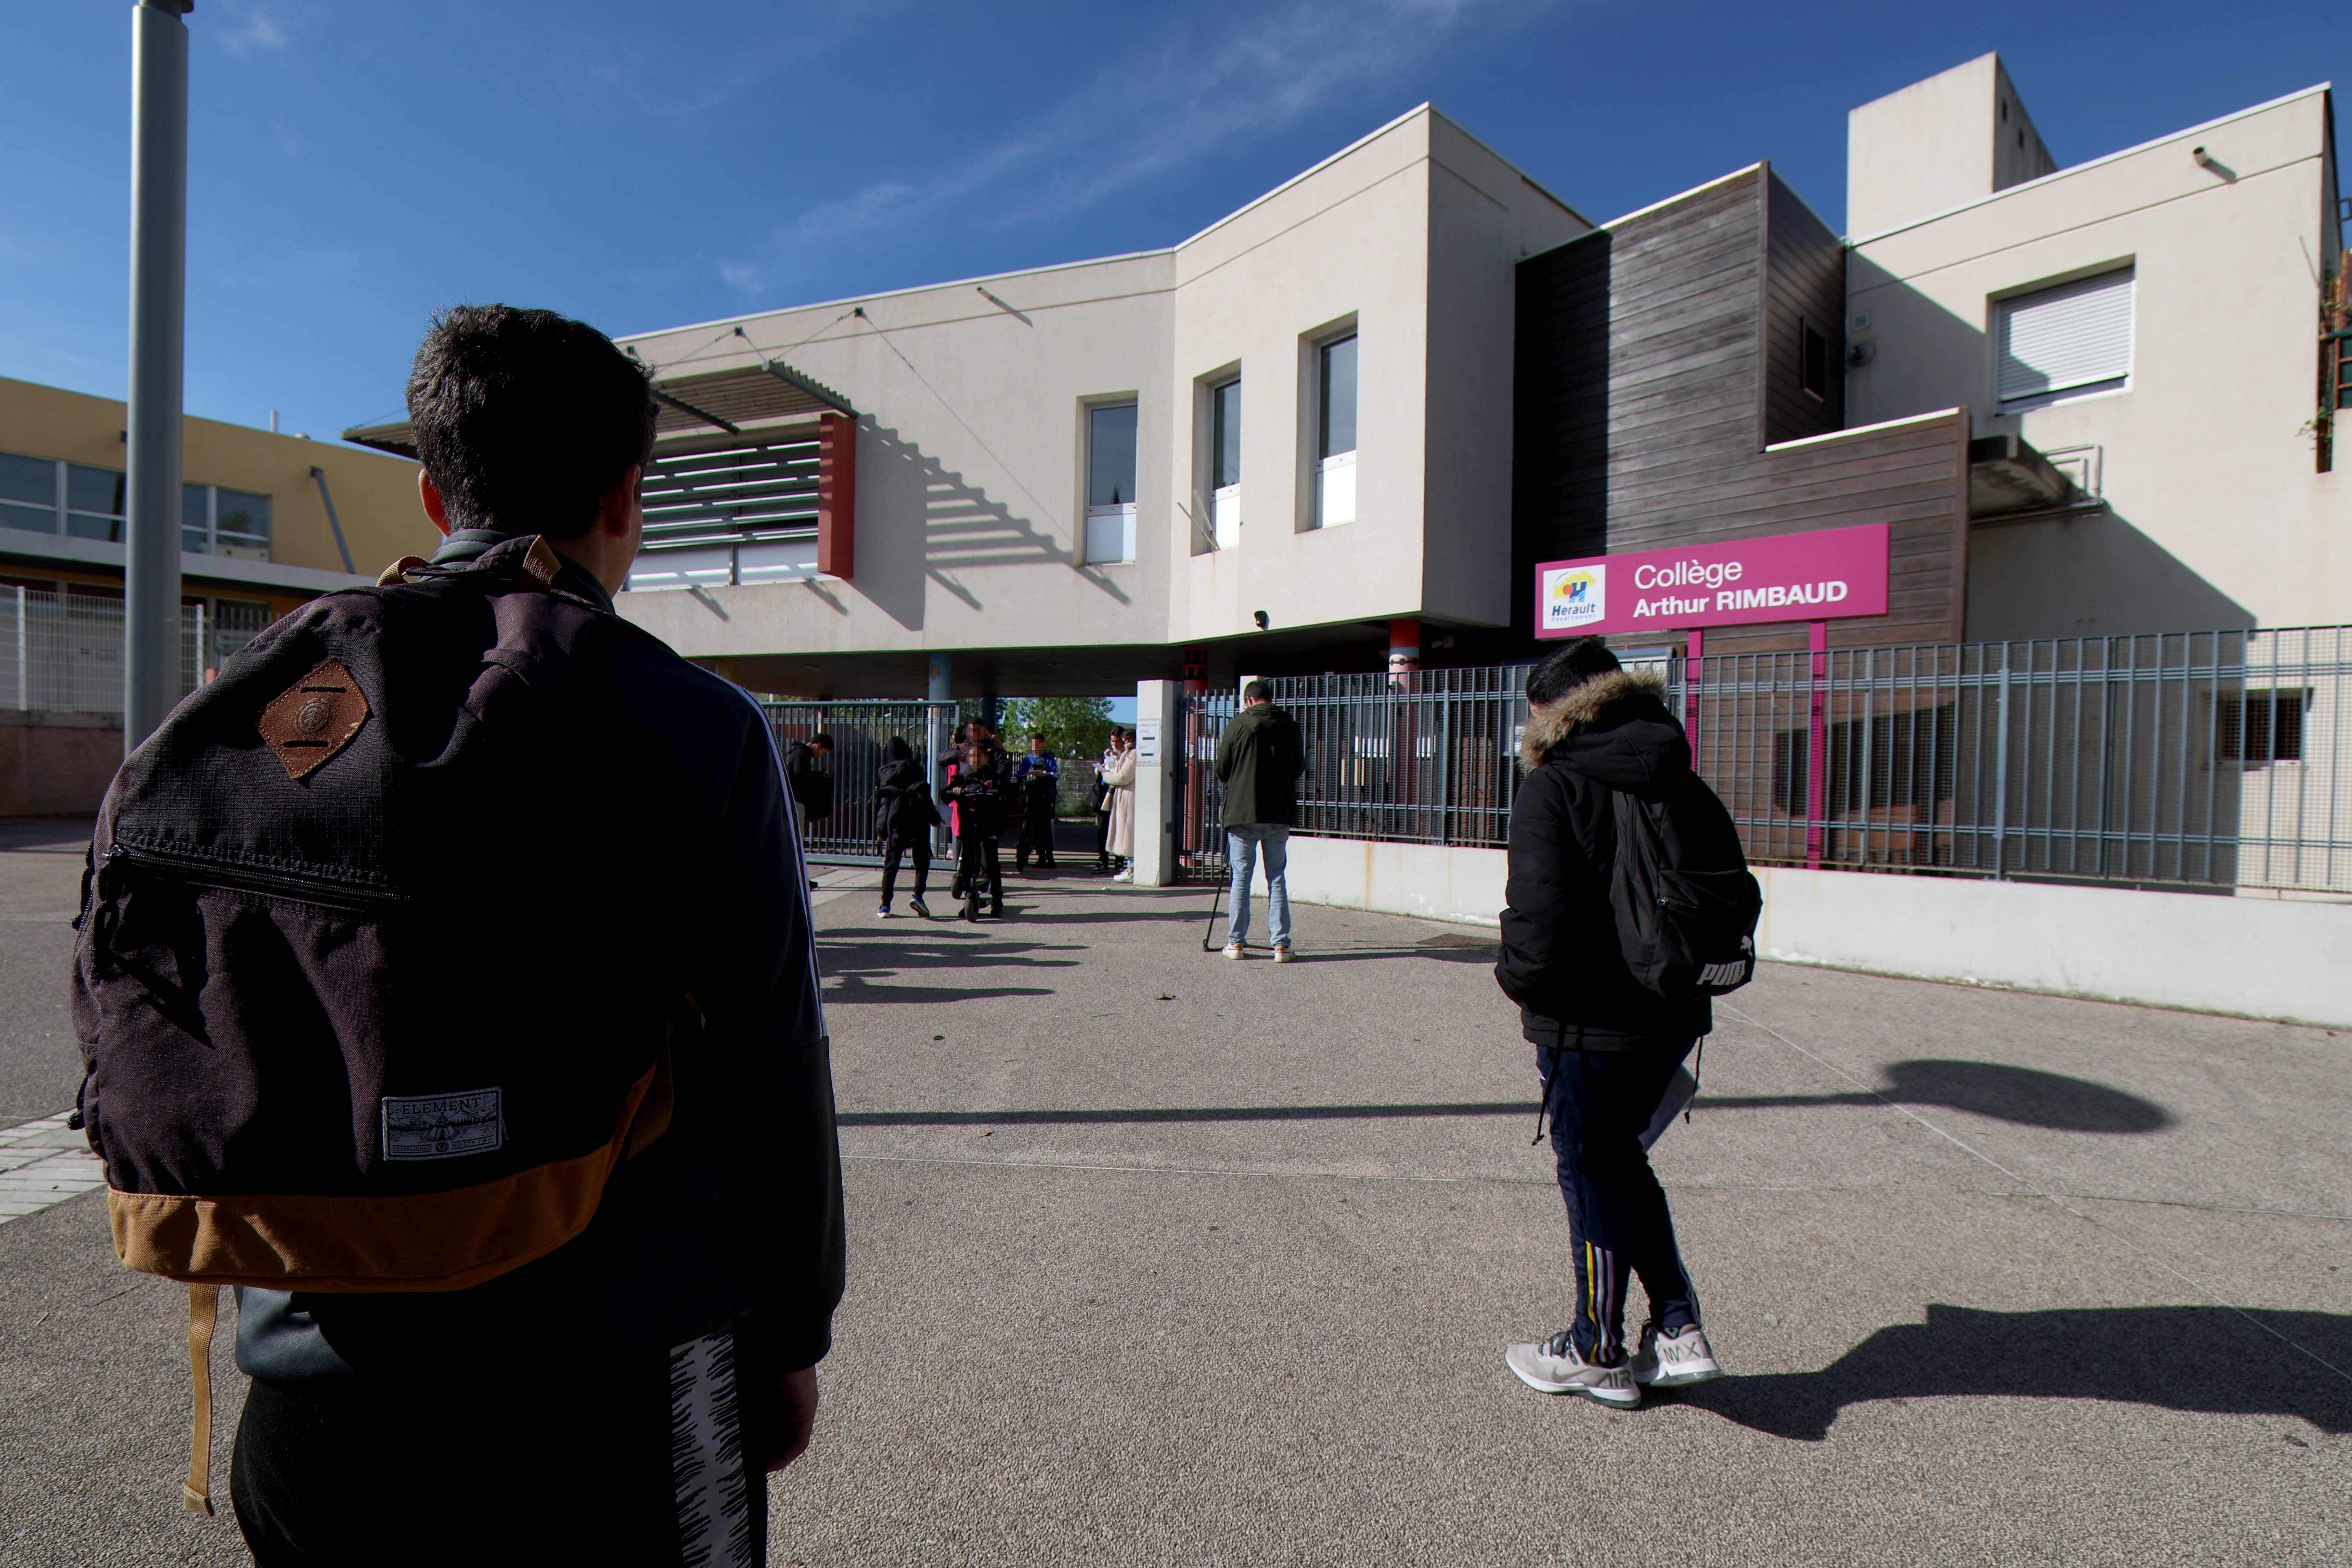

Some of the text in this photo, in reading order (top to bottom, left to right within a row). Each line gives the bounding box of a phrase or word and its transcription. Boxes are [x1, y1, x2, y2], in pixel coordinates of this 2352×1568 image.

[1634, 559, 1743, 589] Collège
[1632, 581, 1848, 618] Arthur RIMBAUD
[1696, 960, 1746, 985] PUM
[402, 1097, 482, 1115] ELEMENT
[1596, 1370, 1632, 1387] AIR
